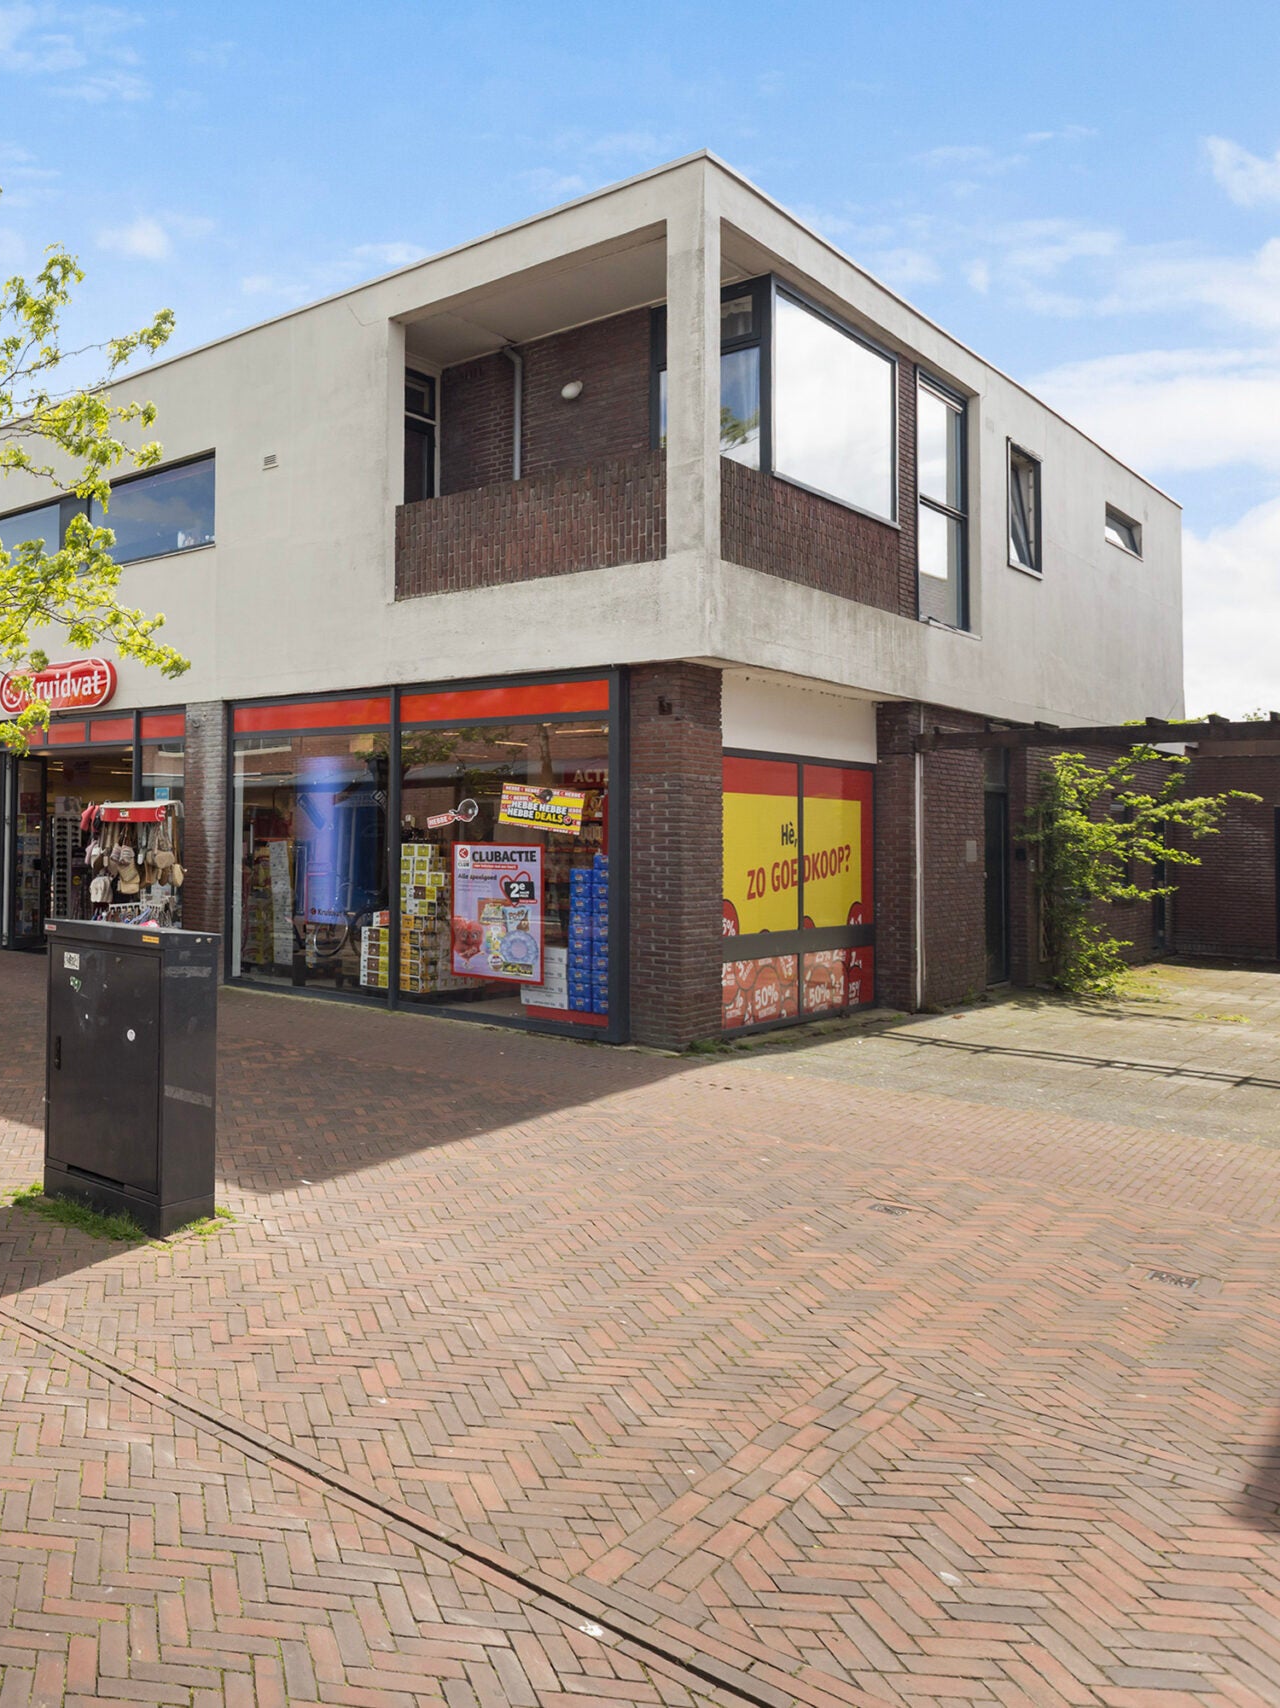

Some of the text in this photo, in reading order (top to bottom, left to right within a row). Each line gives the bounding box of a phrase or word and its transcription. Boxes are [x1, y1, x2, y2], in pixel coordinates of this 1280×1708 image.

[507, 807, 563, 823] HEBBE DEALS
[511, 801, 567, 815] HEBBE HEBBE
[428, 816, 448, 825] HEBBE
[781, 821, 798, 847] Hè,
[472, 850, 537, 862] CLUBACTIE
[746, 844, 851, 900] ZO GOEDKOOP?
[755, 983, 779, 1010] 50%
[809, 983, 831, 1008] 50%
